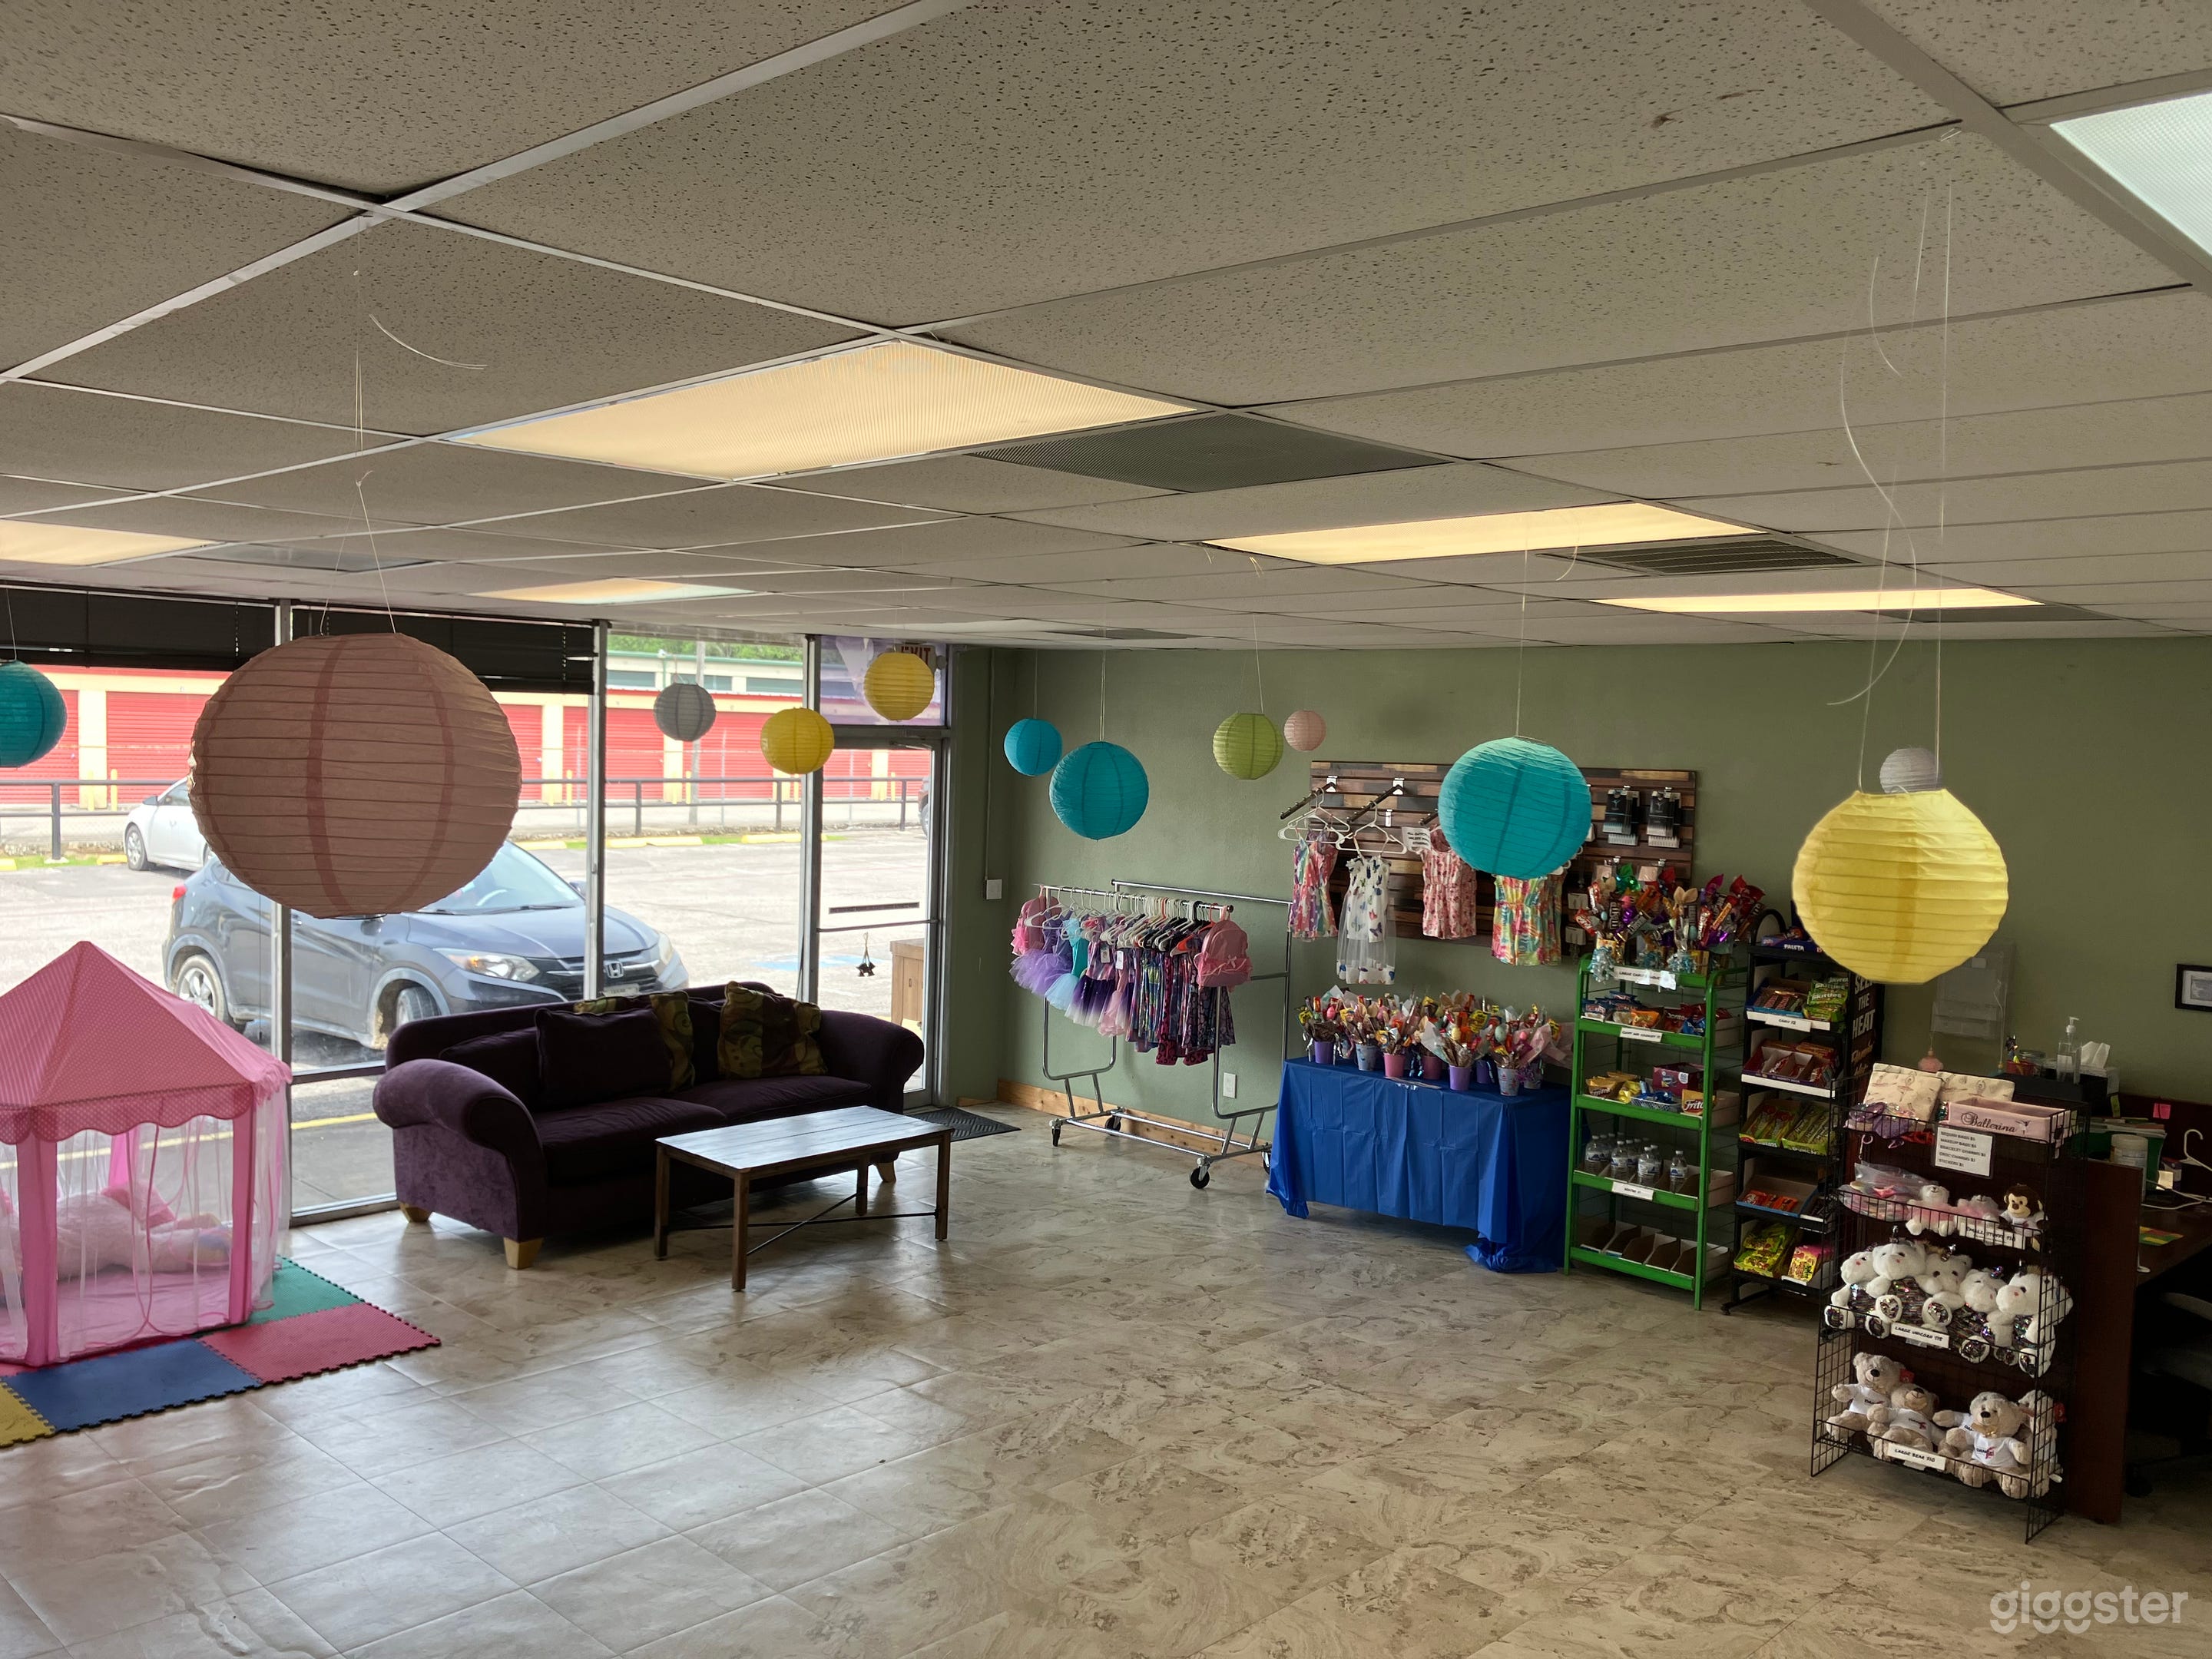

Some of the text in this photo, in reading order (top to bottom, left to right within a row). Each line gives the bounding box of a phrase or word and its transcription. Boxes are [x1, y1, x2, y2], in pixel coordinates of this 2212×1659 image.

[1858, 992, 1870, 1012] THE
[1852, 1008, 1876, 1040] HEAT
[1961, 1111, 2017, 1134] Ballerina
[1912, 1331, 1933, 1339] UNICORN
